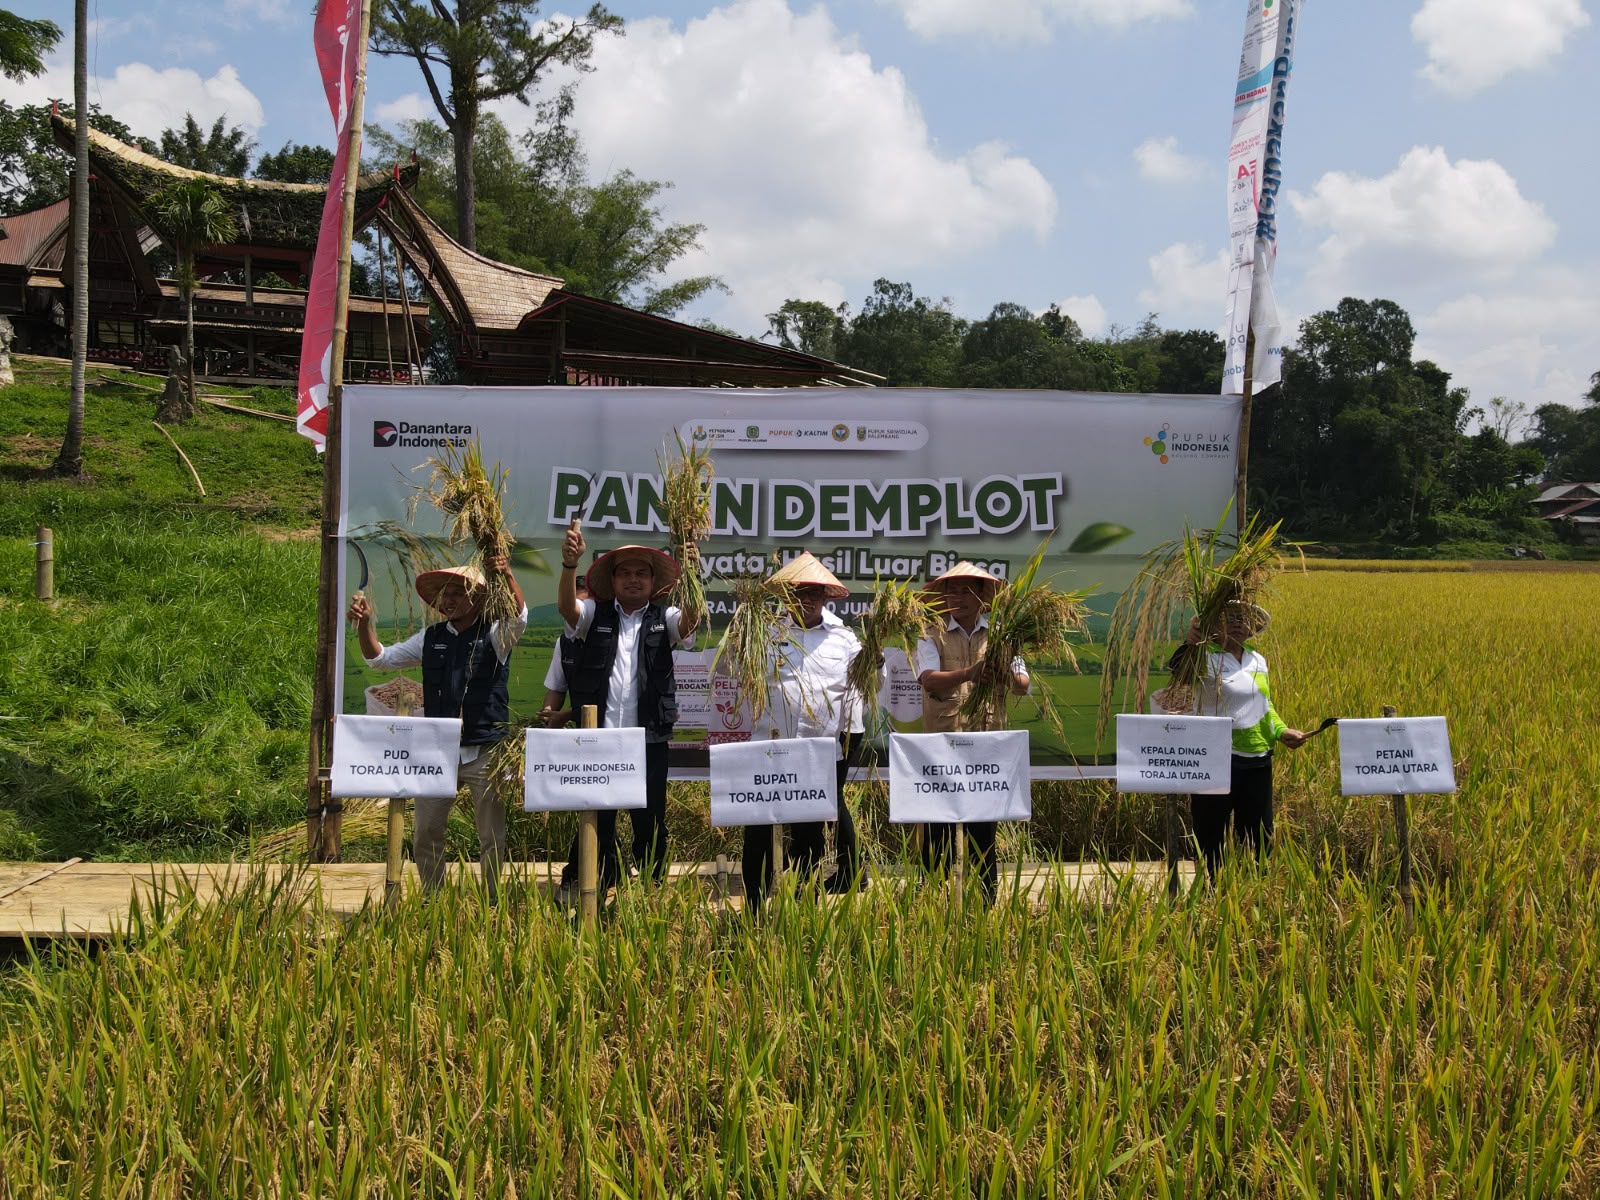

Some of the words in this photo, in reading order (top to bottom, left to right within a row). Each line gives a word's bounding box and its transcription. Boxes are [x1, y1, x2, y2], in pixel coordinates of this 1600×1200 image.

[399, 422, 472, 435] Danantara
[399, 435, 468, 448] Indonesia
[1171, 433, 1231, 443] PUPUK
[1171, 443, 1230, 452] INDONESIA
[548, 467, 760, 536] PANN
[768, 471, 1062, 537] DEMPLOT
[699, 551, 773, 578] yata,
[782, 549, 851, 574] Hsil
[859, 551, 922, 576] Luar
[930, 553, 1007, 580] Bisa
[840, 601, 874, 615] JUN
[384, 750, 410, 760] PUD
[1140, 746, 1176, 756] KEPALA
[1178, 747, 1207, 756] DINAS
[1376, 749, 1414, 760] PETANI
[534, 764, 546, 772] PT
[548, 764, 580, 772] PUPUK
[583, 763, 636, 772] INDONESIA
[1148, 758, 1200, 768] PERTANIAN
[350, 765, 400, 776] TORAJA
[403, 765, 443, 776] UTARA
[922, 765, 962, 776] KETUA
[965, 764, 1000, 775] DPRD
[1355, 764, 1400, 775] TORAJA
[1403, 763, 1439, 774] UTARA
[560, 775, 610, 786] (PERSERO)
[754, 773, 798, 785] BUPATI
[1140, 770, 1178, 780] TORAJA
[1180, 771, 1211, 781] UTARA
[914, 782, 966, 794] TORAJA
[968, 781, 1010, 792] UTARA
[728, 791, 781, 803] TORAJA
[784, 789, 827, 801] UTARA
